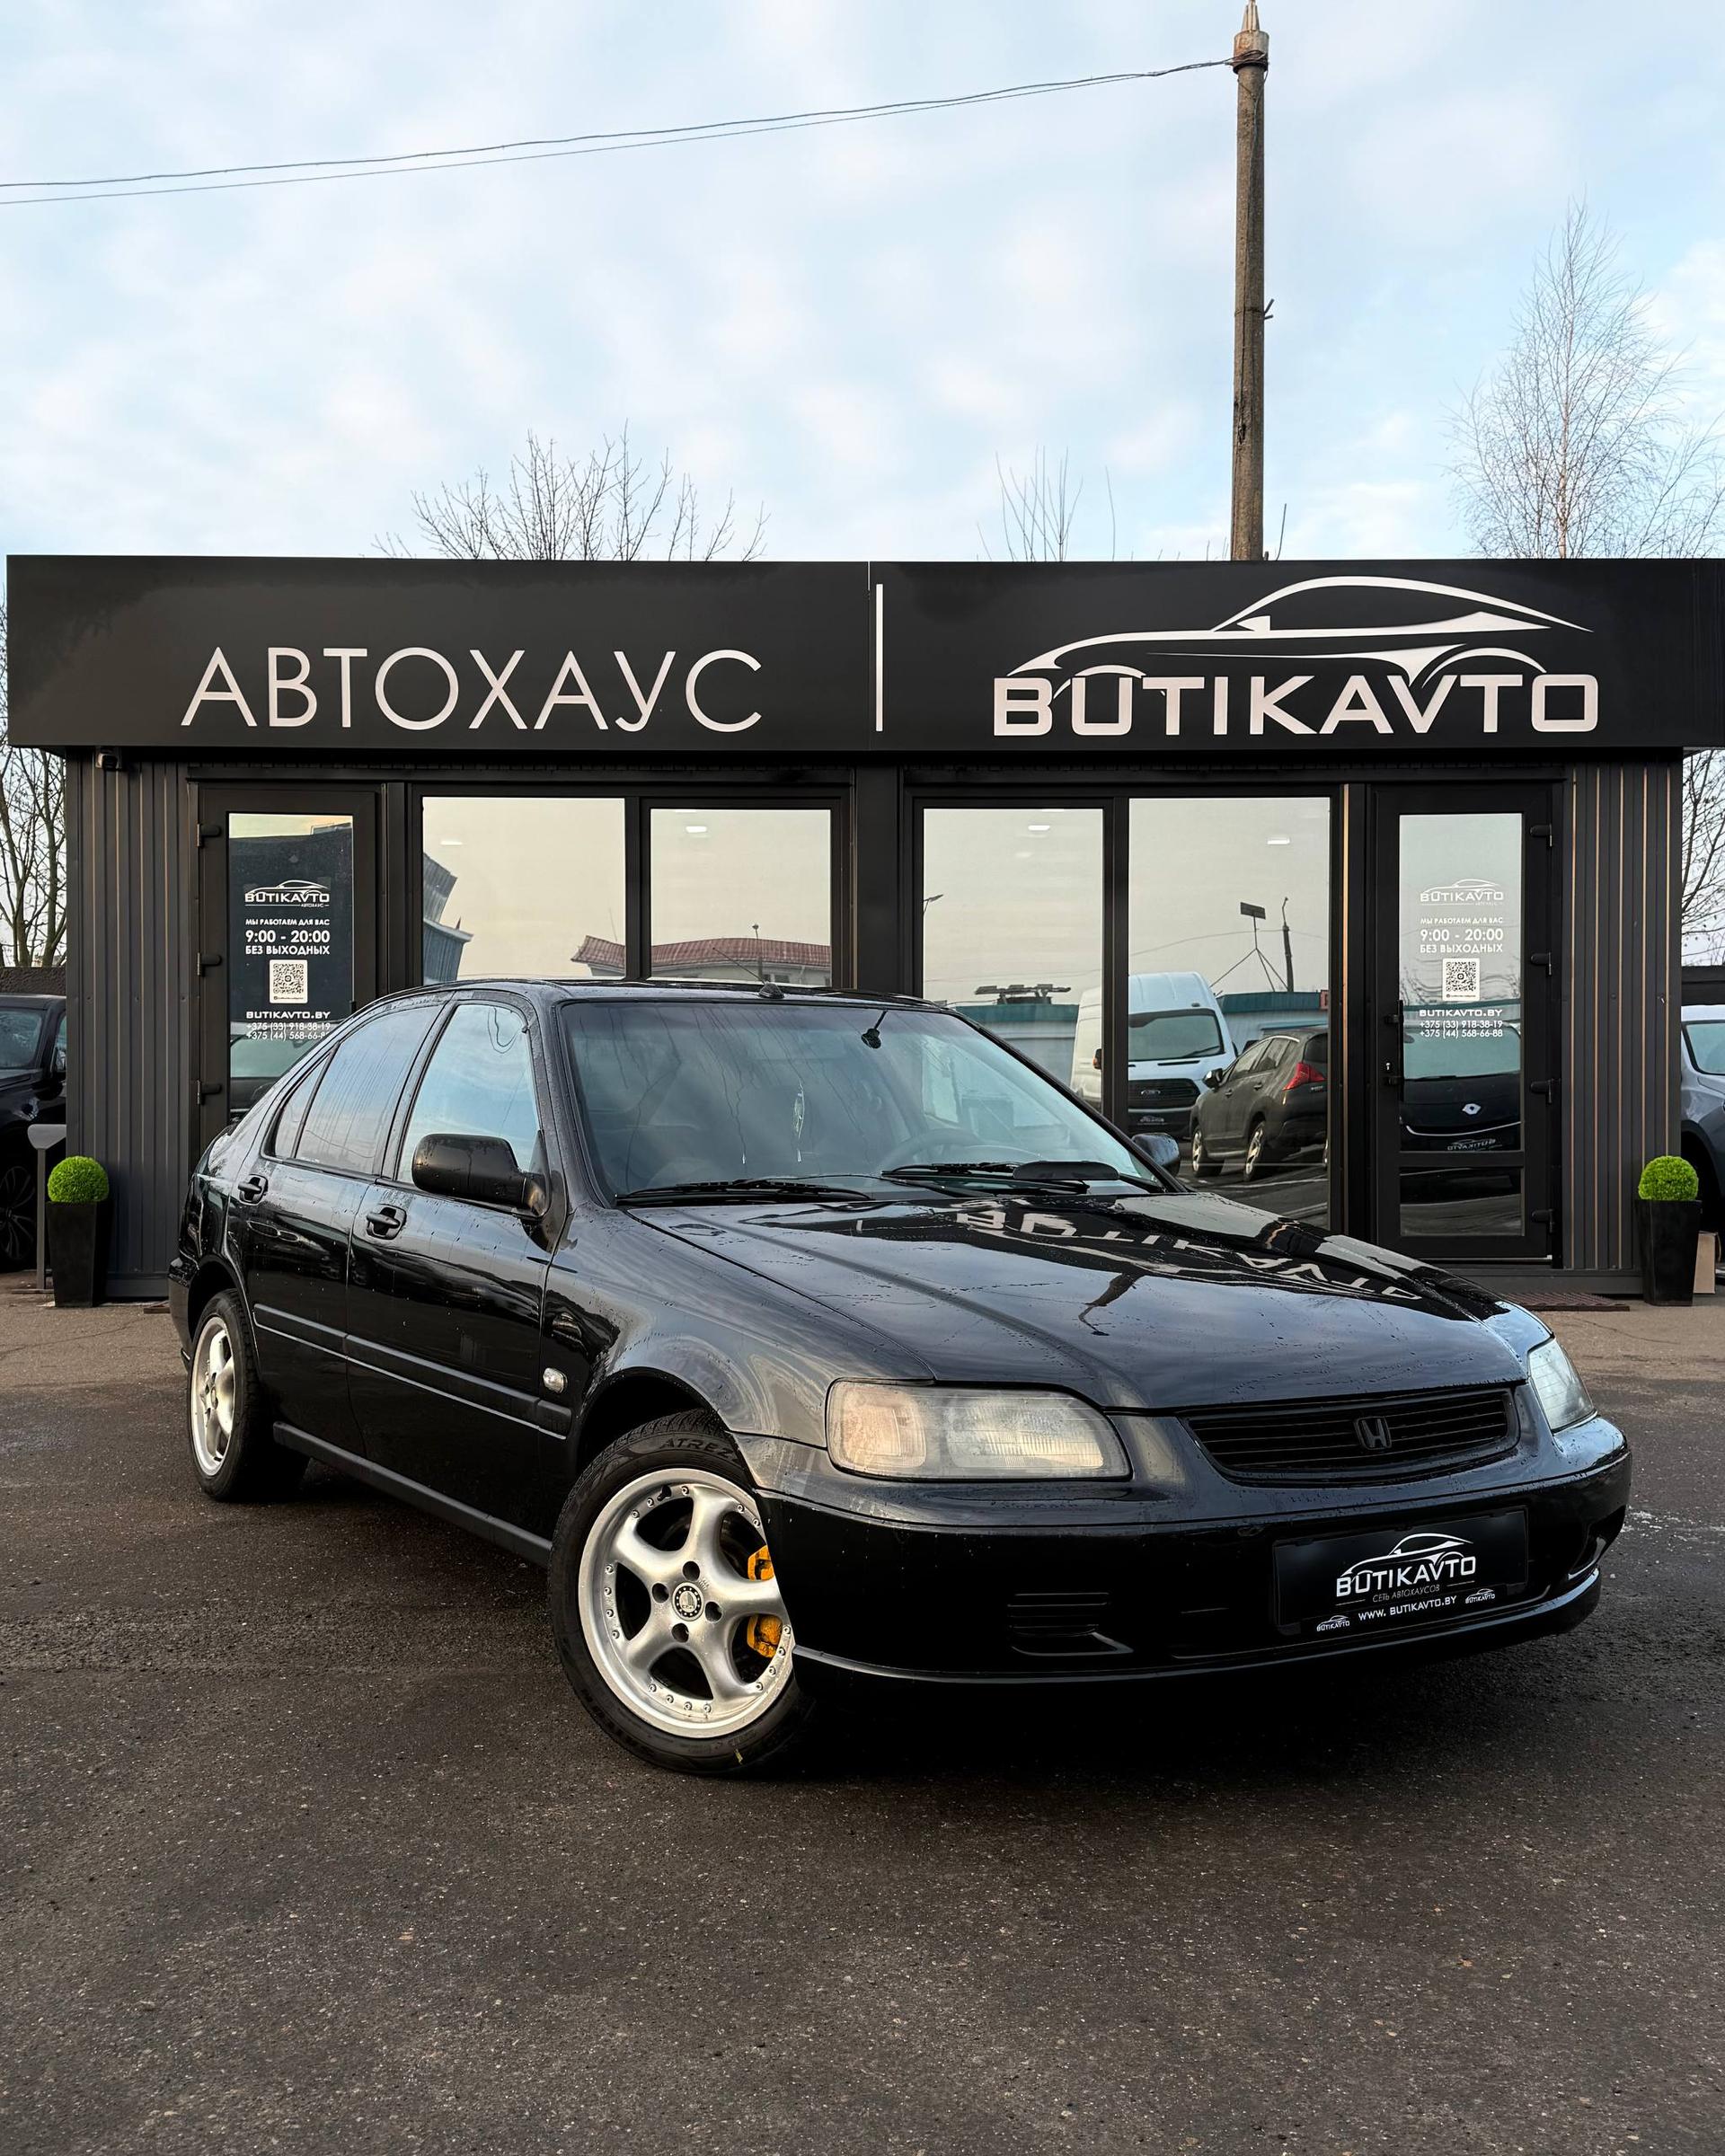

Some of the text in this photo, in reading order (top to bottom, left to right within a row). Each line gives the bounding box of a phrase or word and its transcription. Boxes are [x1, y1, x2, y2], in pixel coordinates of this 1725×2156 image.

[181, 647, 762, 732] АВТОХАУС
[994, 674, 1598, 737] BUTIKAVTO
[244, 893, 330, 903] BUTIKAVTO
[1420, 891, 1504, 902] BUTIKAVTO
[298, 918, 314, 926] ДЛЯ
[1473, 917, 1487, 925] ДЛЯ
[245, 930, 276, 943] 9:00
[290, 930, 331, 943] 20:00
[1420, 929, 1450, 941] 9:00
[1464, 928, 1504, 941] 20:00
[245, 945, 331, 956] БЕЗ ВЫХОДНЫХ
[1420, 943, 1503, 954] БЕЗ ВЫХОДНЫХ
[245, 1011, 331, 1019] BUTIKAVTO.BY
[1419, 1009, 1503, 1017] BUTIKAVTO.BY
[246, 1021, 331, 1032] +375 (33) 918-38-19
[1420, 1020, 1503, 1030] +375 (33) 918-38-19
[246, 1030, 330, 1041] +375 (44) 568-66-8
[1420, 1029, 1503, 1039] +375 (44) 568-66-88
[1336, 1556, 1476, 1597] BUTIKAVTO
[1372, 1584, 1440, 1604] СЕТЬ АВТОХАУСОВ
[1464, 1593, 1496, 1604] BUTIKAVTO
[1358, 1595, 1457, 1621] WWW. BUTIKAVTO.BY
[1316, 1620, 1350, 1632] BUTIKAVTO
